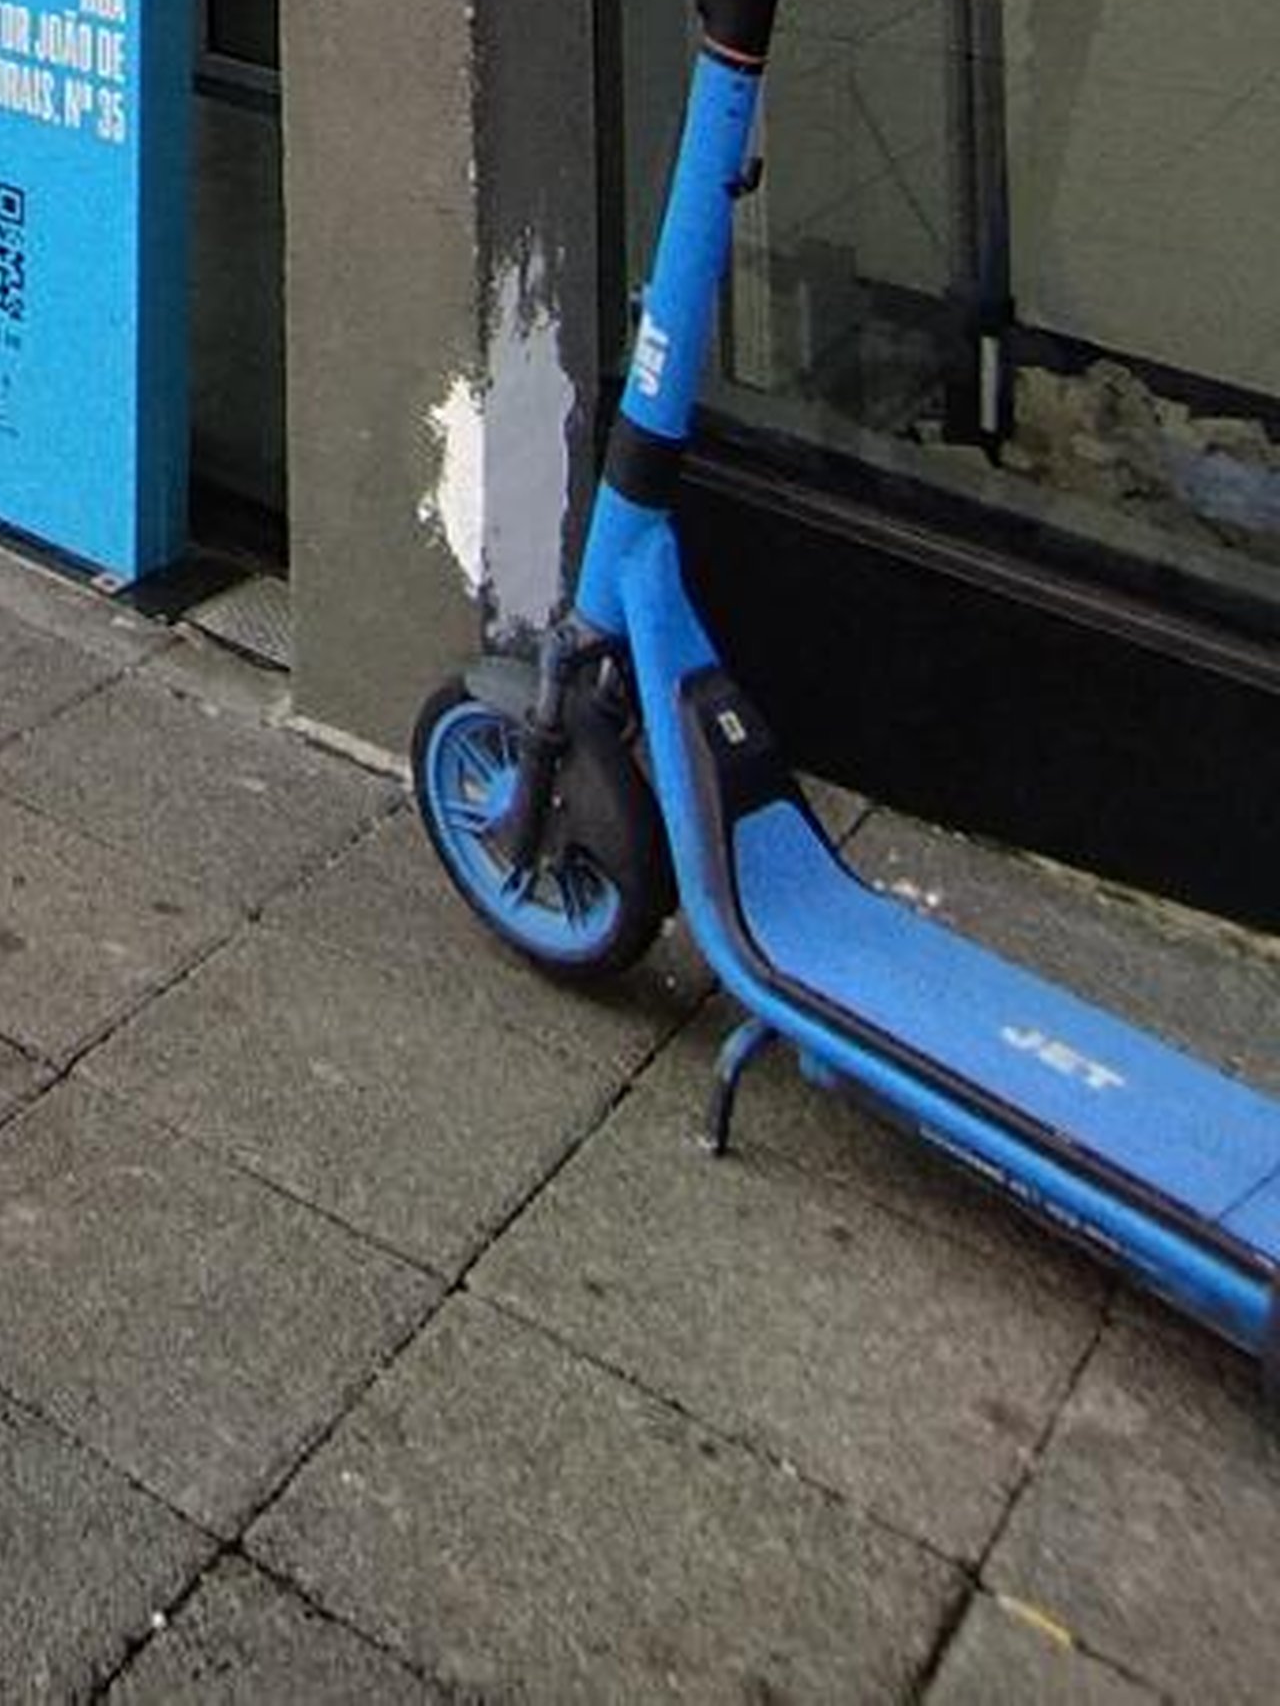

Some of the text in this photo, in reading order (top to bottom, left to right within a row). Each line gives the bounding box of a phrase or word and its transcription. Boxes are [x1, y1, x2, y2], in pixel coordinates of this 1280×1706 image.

[34, 9, 93, 73] JOÃO
[96, 26, 127, 85] DE
[96, 87, 127, 144] 35
[635, 314, 668, 397] JET
[1001, 1026, 1126, 1088] JET
